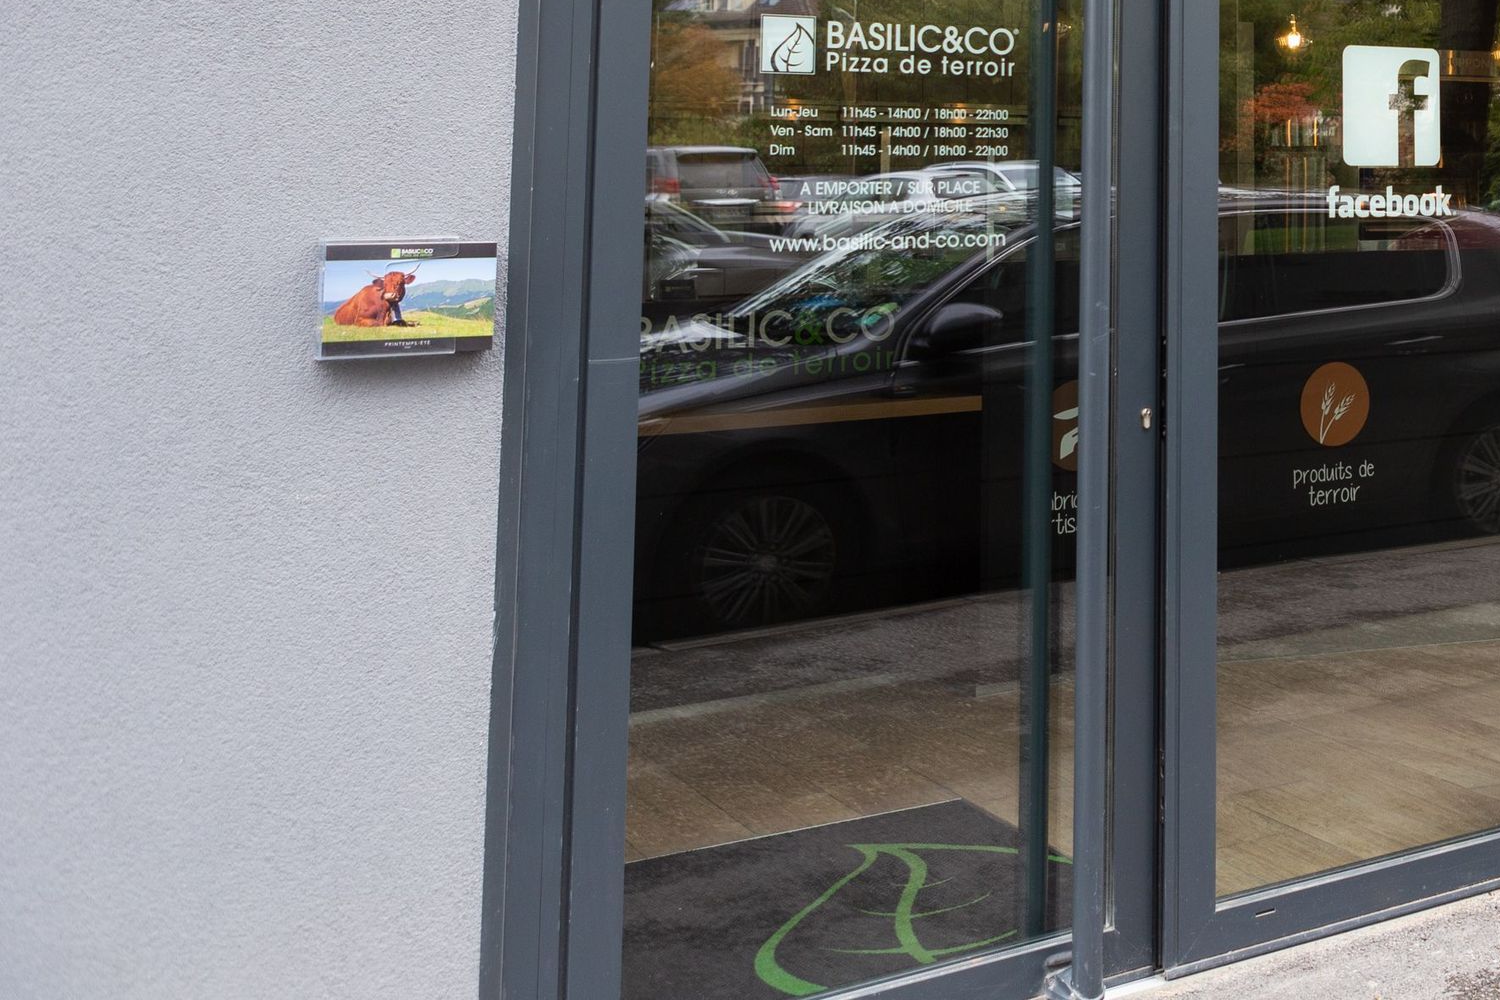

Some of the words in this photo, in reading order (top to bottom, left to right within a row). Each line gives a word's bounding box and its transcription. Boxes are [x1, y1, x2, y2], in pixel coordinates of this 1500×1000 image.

[826, 52, 888, 73] Pizza
[900, 55, 932, 75] de
[942, 56, 1016, 77] terroir
[842, 107, 877, 119] 11h45
[888, 108, 921, 120] 14h00
[934, 108, 967, 120] 18h00
[975, 109, 1009, 121] 22h00
[770, 125, 795, 137] Ven
[805, 125, 833, 137] Sam
[842, 125, 877, 137] 11h45
[888, 126, 921, 138] 14h00
[934, 126, 967, 138] 18h00
[975, 127, 1009, 139] 22h30
[769, 144, 795, 156] Dim
[841, 144, 876, 156] 11h45
[887, 144, 921, 156] 14h00
[934, 145, 967, 157] 18h00
[975, 145, 1009, 157] 22h00
[816, 181, 892, 196] EMPORTER
[907, 181, 935, 195] SUR
[938, 180, 981, 194] PLACE
[808, 200, 886, 215] LIVRAISON
[904, 199, 974, 214] DOMICILE
[769, 231, 1006, 252] www.basilic-and-co.com
[734, 352, 778, 378] de
[794, 345, 893, 376] terroir
[1293, 463, 1353, 489] produits
[1359, 459, 1375, 477] de
[1309, 482, 1360, 506] terroir
